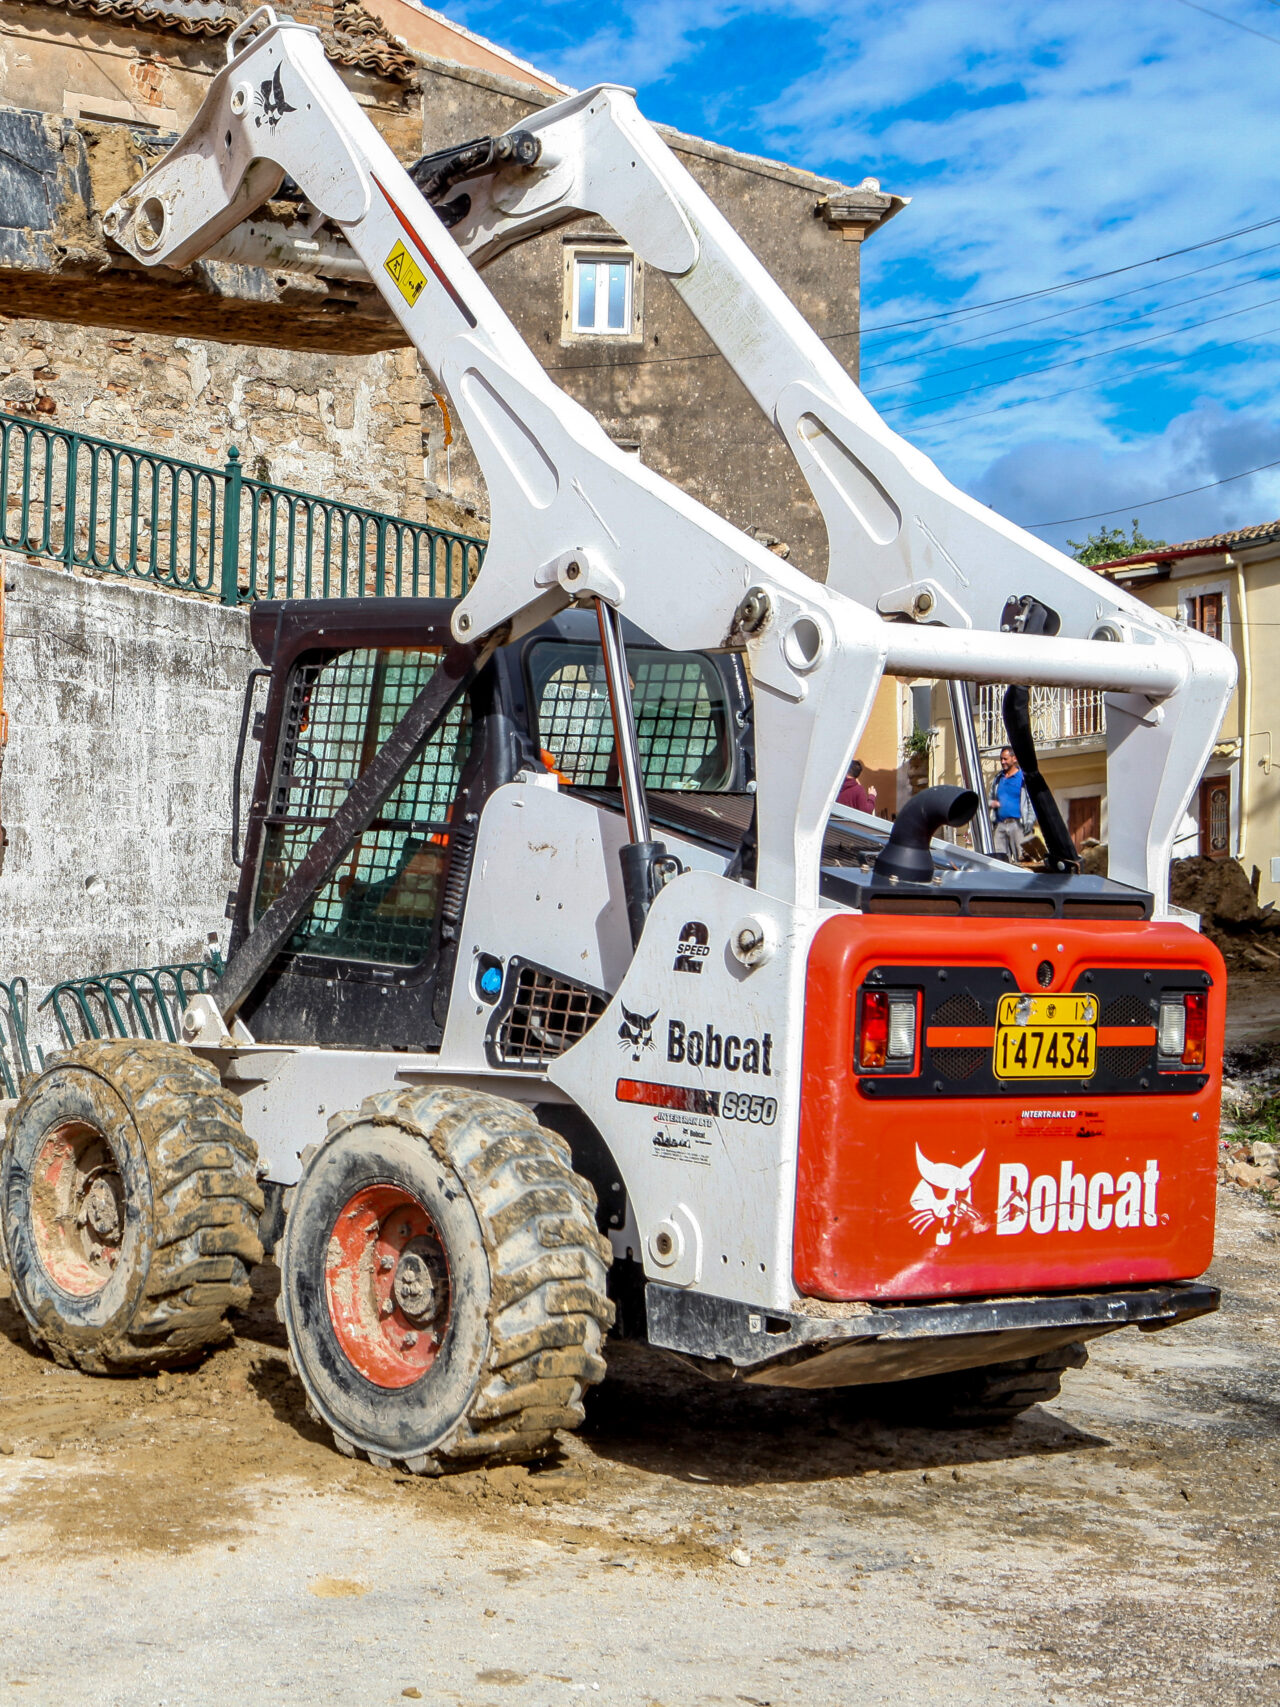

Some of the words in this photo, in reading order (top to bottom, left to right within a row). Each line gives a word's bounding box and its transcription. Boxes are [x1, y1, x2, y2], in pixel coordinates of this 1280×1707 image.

[676, 943, 710, 957] SPEED
[667, 1019, 773, 1077] Bobcat
[1002, 1032, 1090, 1069] 147434
[657, 1111, 698, 1126] INTERTRAK
[698, 1117, 713, 1128] LTD
[722, 1091, 777, 1126] S850
[1021, 1110, 1061, 1119] INTERTRAK
[1062, 1110, 1077, 1119] LTD
[996, 1159, 1160, 1235] Bobcat
